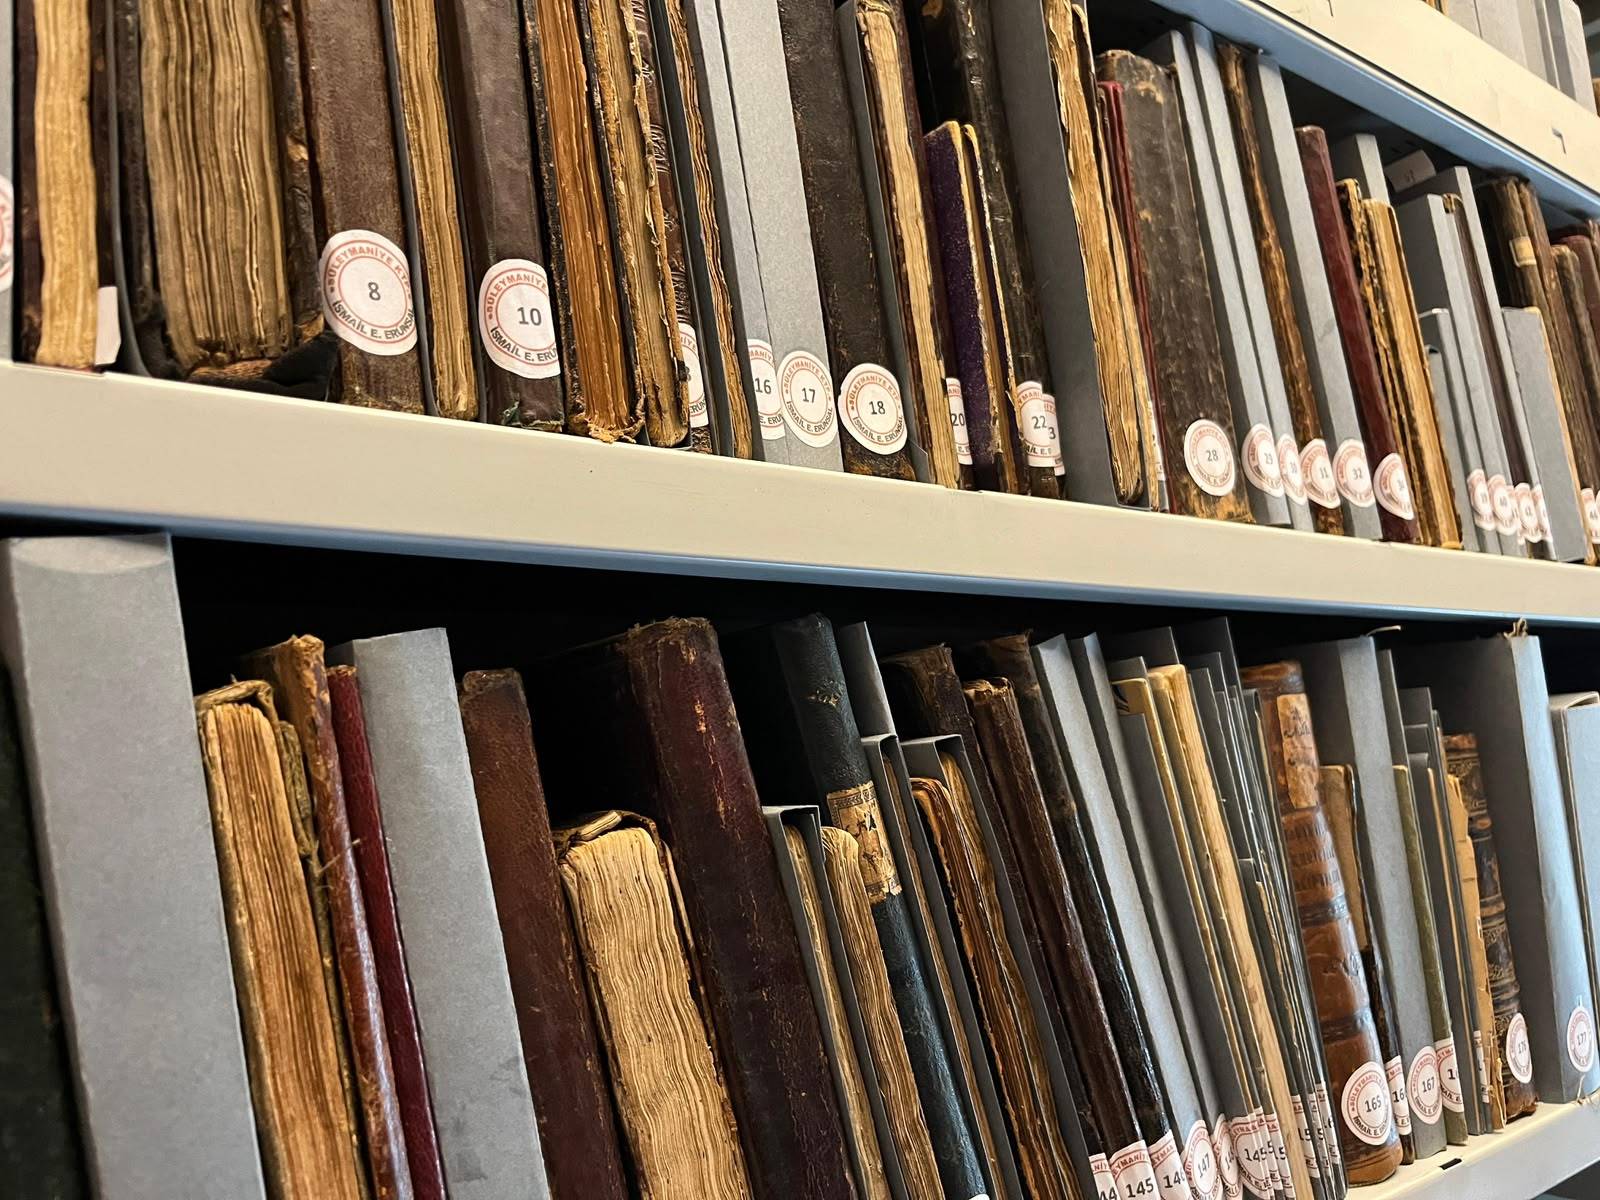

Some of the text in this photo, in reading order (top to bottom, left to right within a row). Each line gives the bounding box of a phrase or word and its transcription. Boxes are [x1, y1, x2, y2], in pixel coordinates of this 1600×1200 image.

[368, 281, 381, 301] 8
[517, 306, 542, 326] 10
[370, 328, 382, 339] E.
[524, 352, 535, 362] E.
[755, 378, 771, 395] 16
[801, 387, 816, 404] 17
[868, 400, 886, 415] 18
[951, 413, 965, 427] 20
[1031, 415, 1047, 429] 22
[1205, 449, 1219, 462] 28
[1422, 1077, 1435, 1093] 167
[1364, 1095, 1382, 1113] 165
[1125, 1177, 1154, 1198] 145
